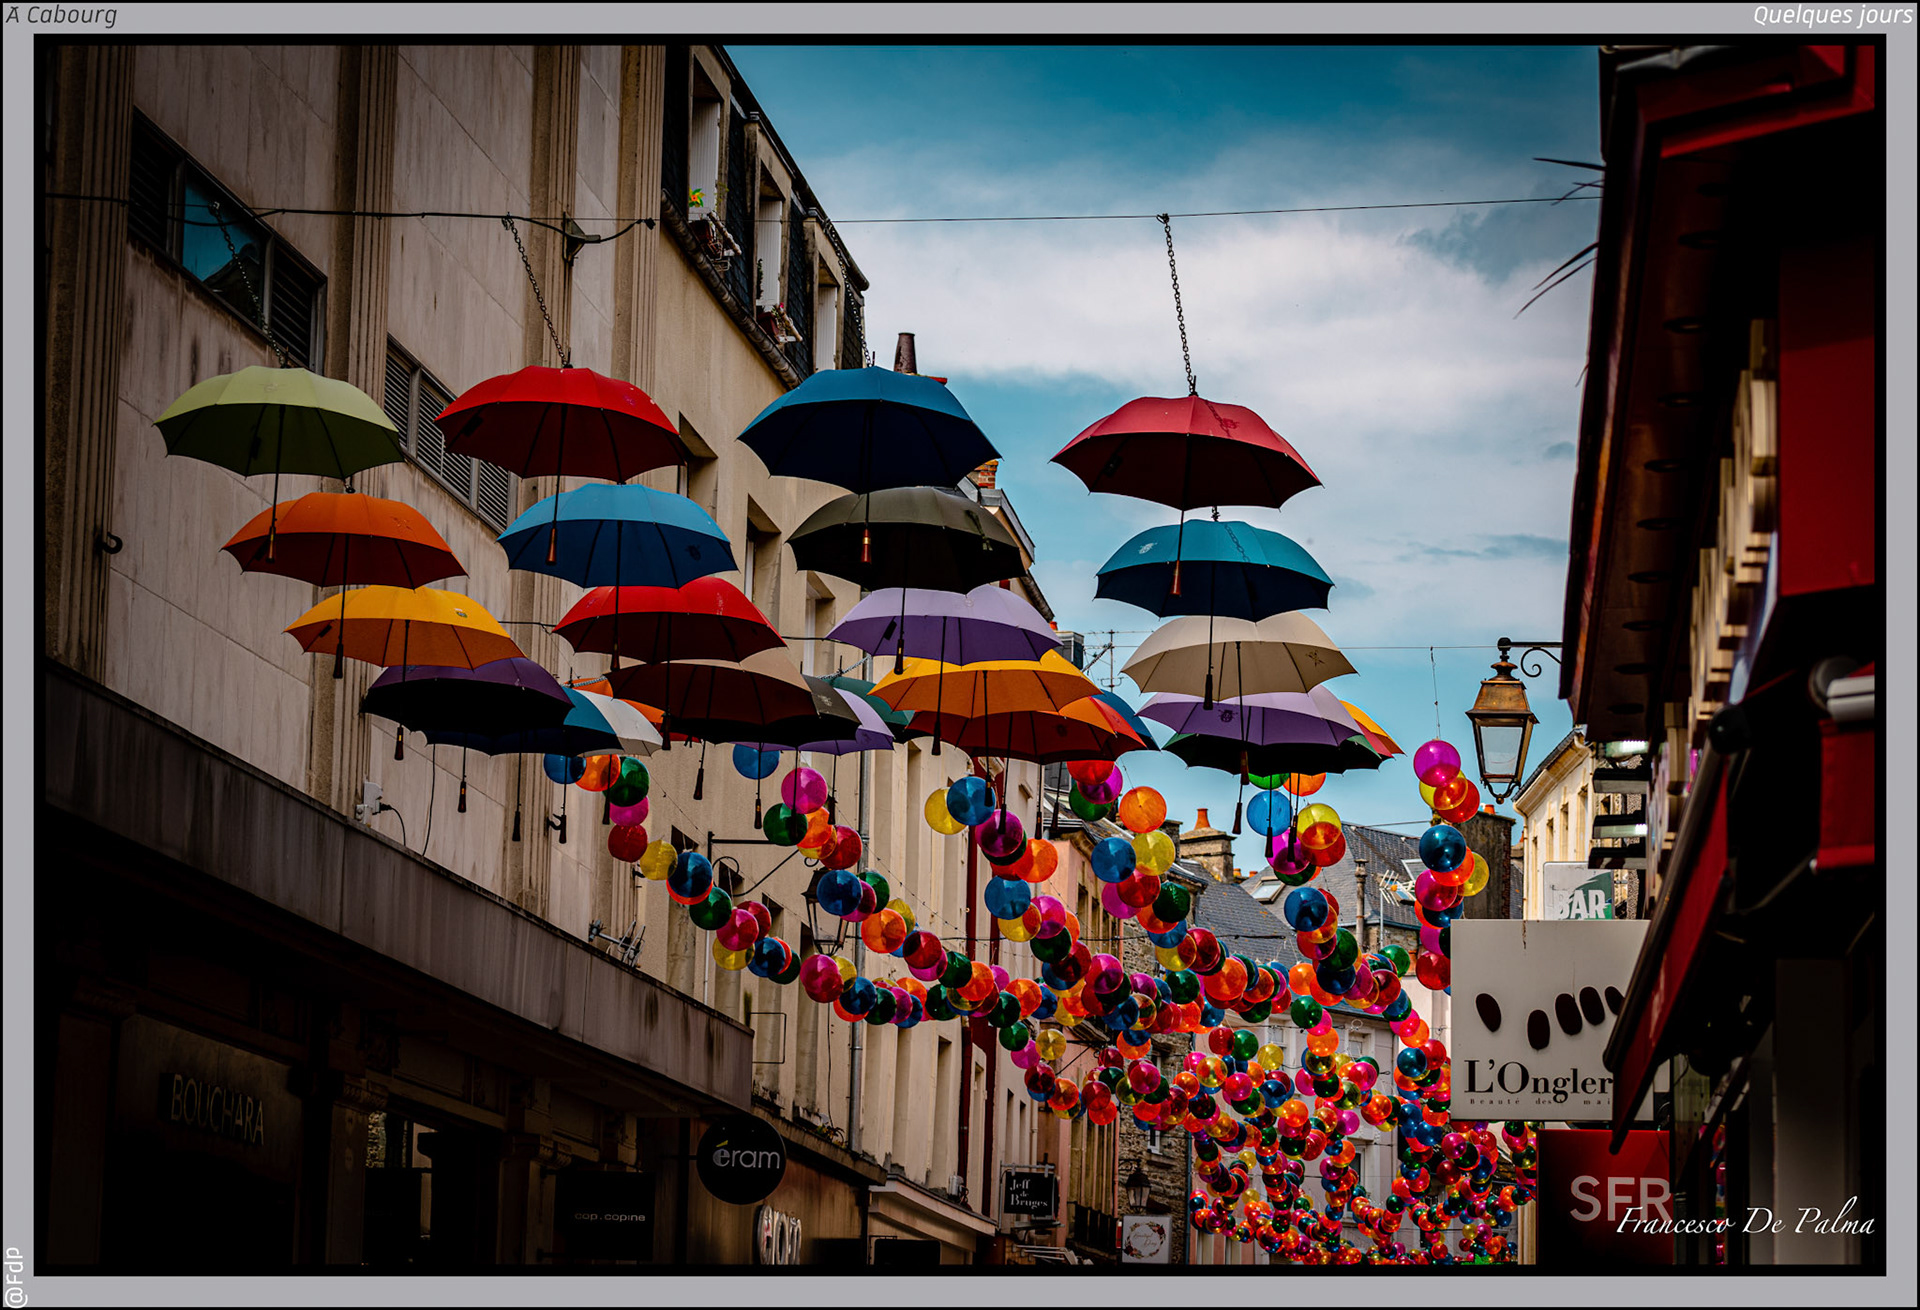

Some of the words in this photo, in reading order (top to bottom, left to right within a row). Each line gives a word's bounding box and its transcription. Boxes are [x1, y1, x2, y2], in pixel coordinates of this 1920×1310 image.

[1553, 889, 1606, 919] BAR
[171, 1073, 265, 1146] BOUCHARA
[1470, 1097, 1520, 1105] Beauté
[1535, 1097, 1552, 1105] des
[1009, 1179, 1031, 1191] Jeff
[1010, 1193, 1048, 1210] Bruges
[1570, 1175, 1673, 1222] SFR
